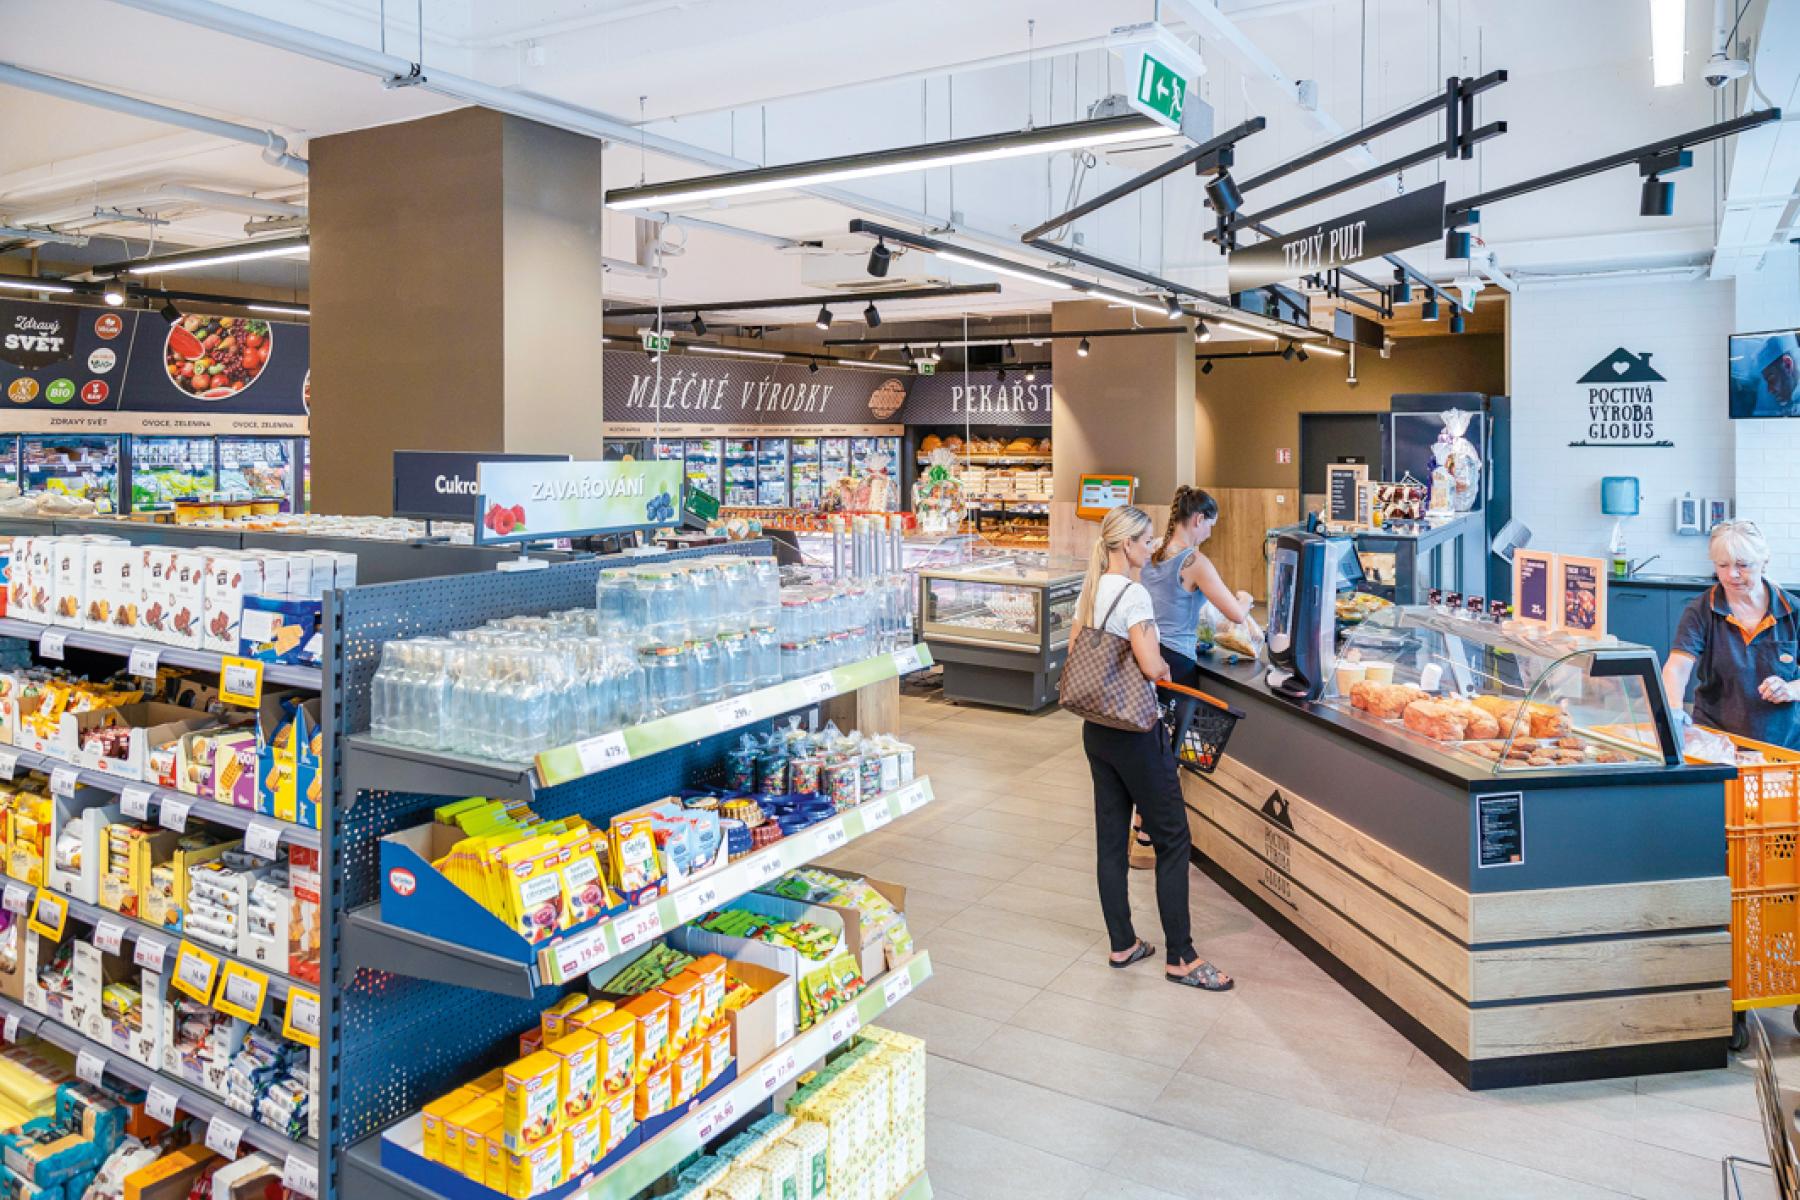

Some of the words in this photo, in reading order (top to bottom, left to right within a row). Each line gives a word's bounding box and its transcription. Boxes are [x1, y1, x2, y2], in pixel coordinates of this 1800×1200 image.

[1328, 220, 1366, 265] PULT
[15, 315, 61, 335] Zdravý
[4, 332, 64, 352] SVĚT
[50, 388, 71, 398] BIO
[626, 370, 729, 410] MLÉČNÉ
[741, 376, 833, 413] VÝROBKY
[952, 380, 1052, 411] PEKAŘST
[1589, 384, 1653, 404] POCTIVÁ
[1589, 402, 1653, 421] VÝROBA
[1589, 423, 1654, 439] GLOBUS
[434, 474, 477, 495] Cukro
[531, 474, 645, 501] ZAVAŘOVÁNÍ
[580, 943, 605, 962] 19.90
